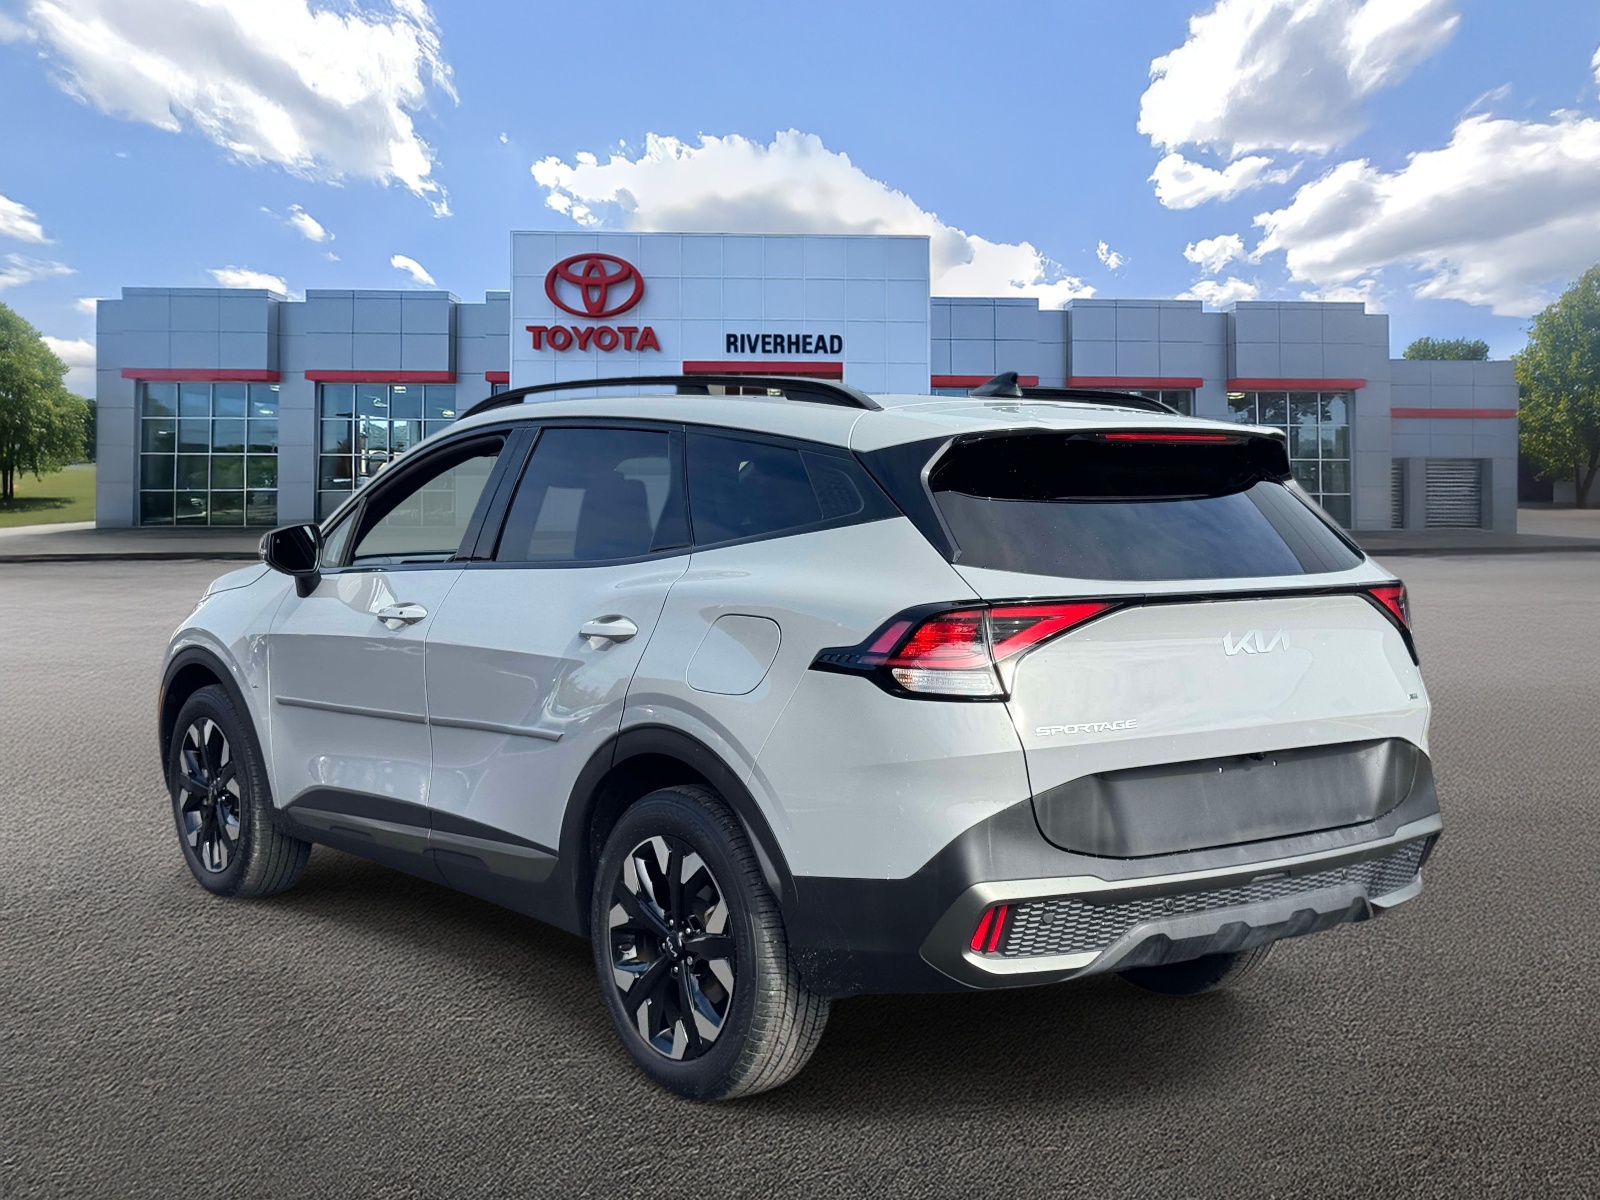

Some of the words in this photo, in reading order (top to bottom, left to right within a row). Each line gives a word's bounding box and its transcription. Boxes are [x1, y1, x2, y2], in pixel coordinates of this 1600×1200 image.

[526, 325, 660, 352] TOYOTA
[726, 333, 843, 354] RIVERHEAD
[1223, 627, 1290, 656] KIA
[1035, 718, 1138, 737] SPORTAGE
